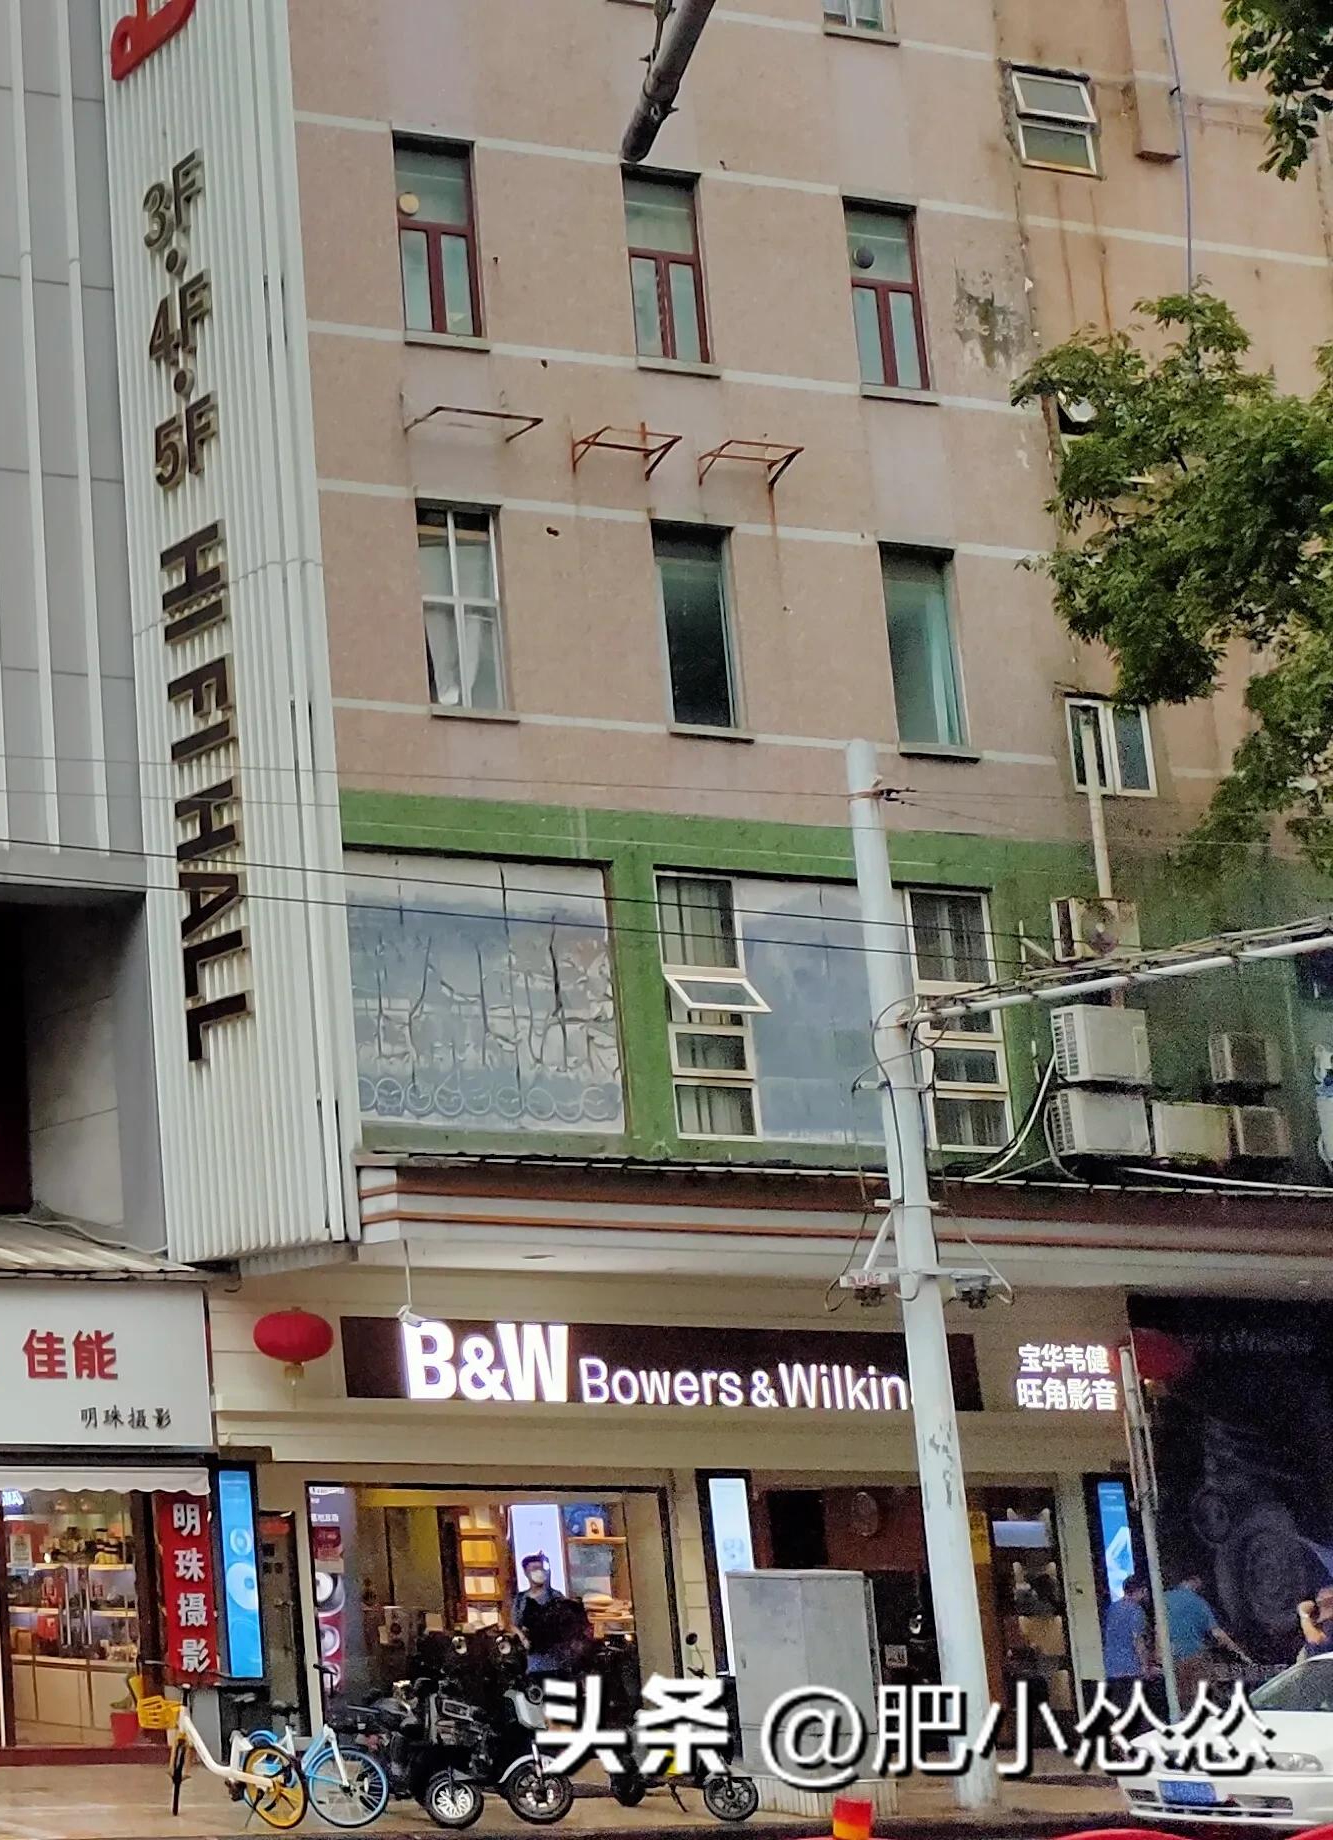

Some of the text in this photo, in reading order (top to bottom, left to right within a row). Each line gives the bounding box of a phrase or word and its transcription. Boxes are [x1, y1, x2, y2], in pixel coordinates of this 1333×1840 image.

[142, 149, 205, 253] 3F
[148, 268, 212, 366] 4F
[154, 391, 218, 491] 5F
[175, 775, 258, 1064] HALL
[22, 1329, 119, 1381] 佳能
[400, 1320, 570, 1403] B&W
[578, 1357, 744, 1406] Bowers
[779, 1361, 910, 1411] Wilkin
[1016, 1377, 1118, 1411] 旺角影音
[1018, 1343, 1111, 1374] 宝华韦健
[79, 1404, 173, 1431] 明珠摄影
[172, 1502, 212, 1674] 明珠摄影
